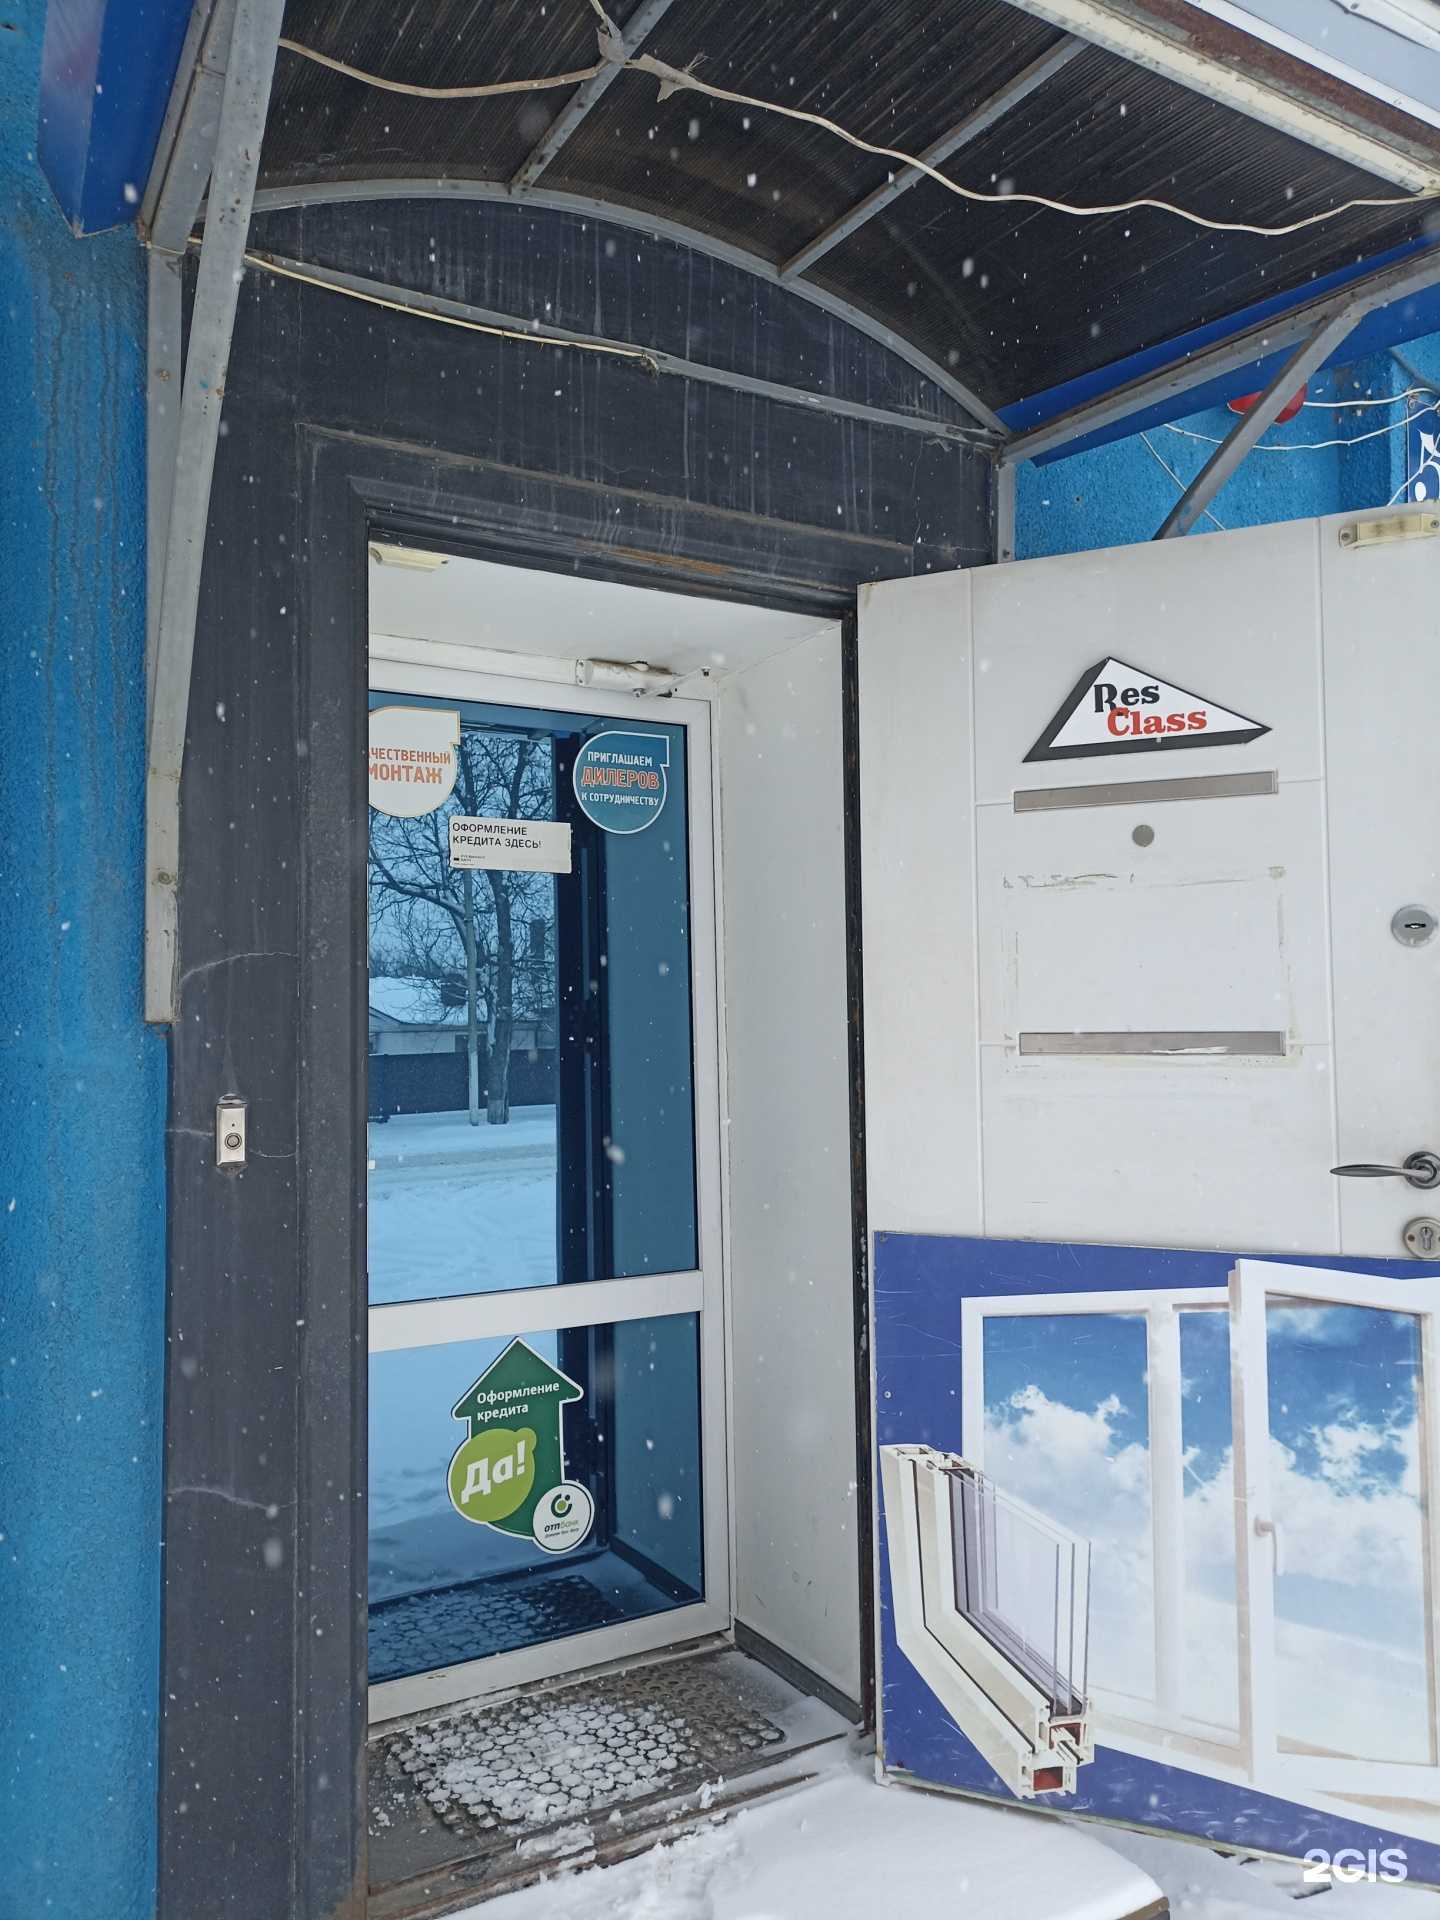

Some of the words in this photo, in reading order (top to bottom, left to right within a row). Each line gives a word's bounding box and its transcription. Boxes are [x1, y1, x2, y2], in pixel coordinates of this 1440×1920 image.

[1094, 683, 1160, 713] Res
[1107, 707, 1207, 736] Class
[369, 747, 451, 765] ЧЕСТВЕННЫЙ
[587, 751, 653, 767] ПРИГЛАШАЕМ
[581, 766, 659, 790] ДИЛЕРОВ
[581, 793, 587, 801] К
[589, 792, 659, 806] СОТРУДНИЧЕСТВУ
[452, 822, 528, 836] ОФОРМЛЕНИЕ
[452, 835, 502, 847] КРЕДИТА
[505, 838, 542, 849] ЗДЕСЬ!
[477, 1382, 560, 1405] Оформление
[477, 1404, 529, 1422] кредита
[461, 1440, 526, 1504] Да!
